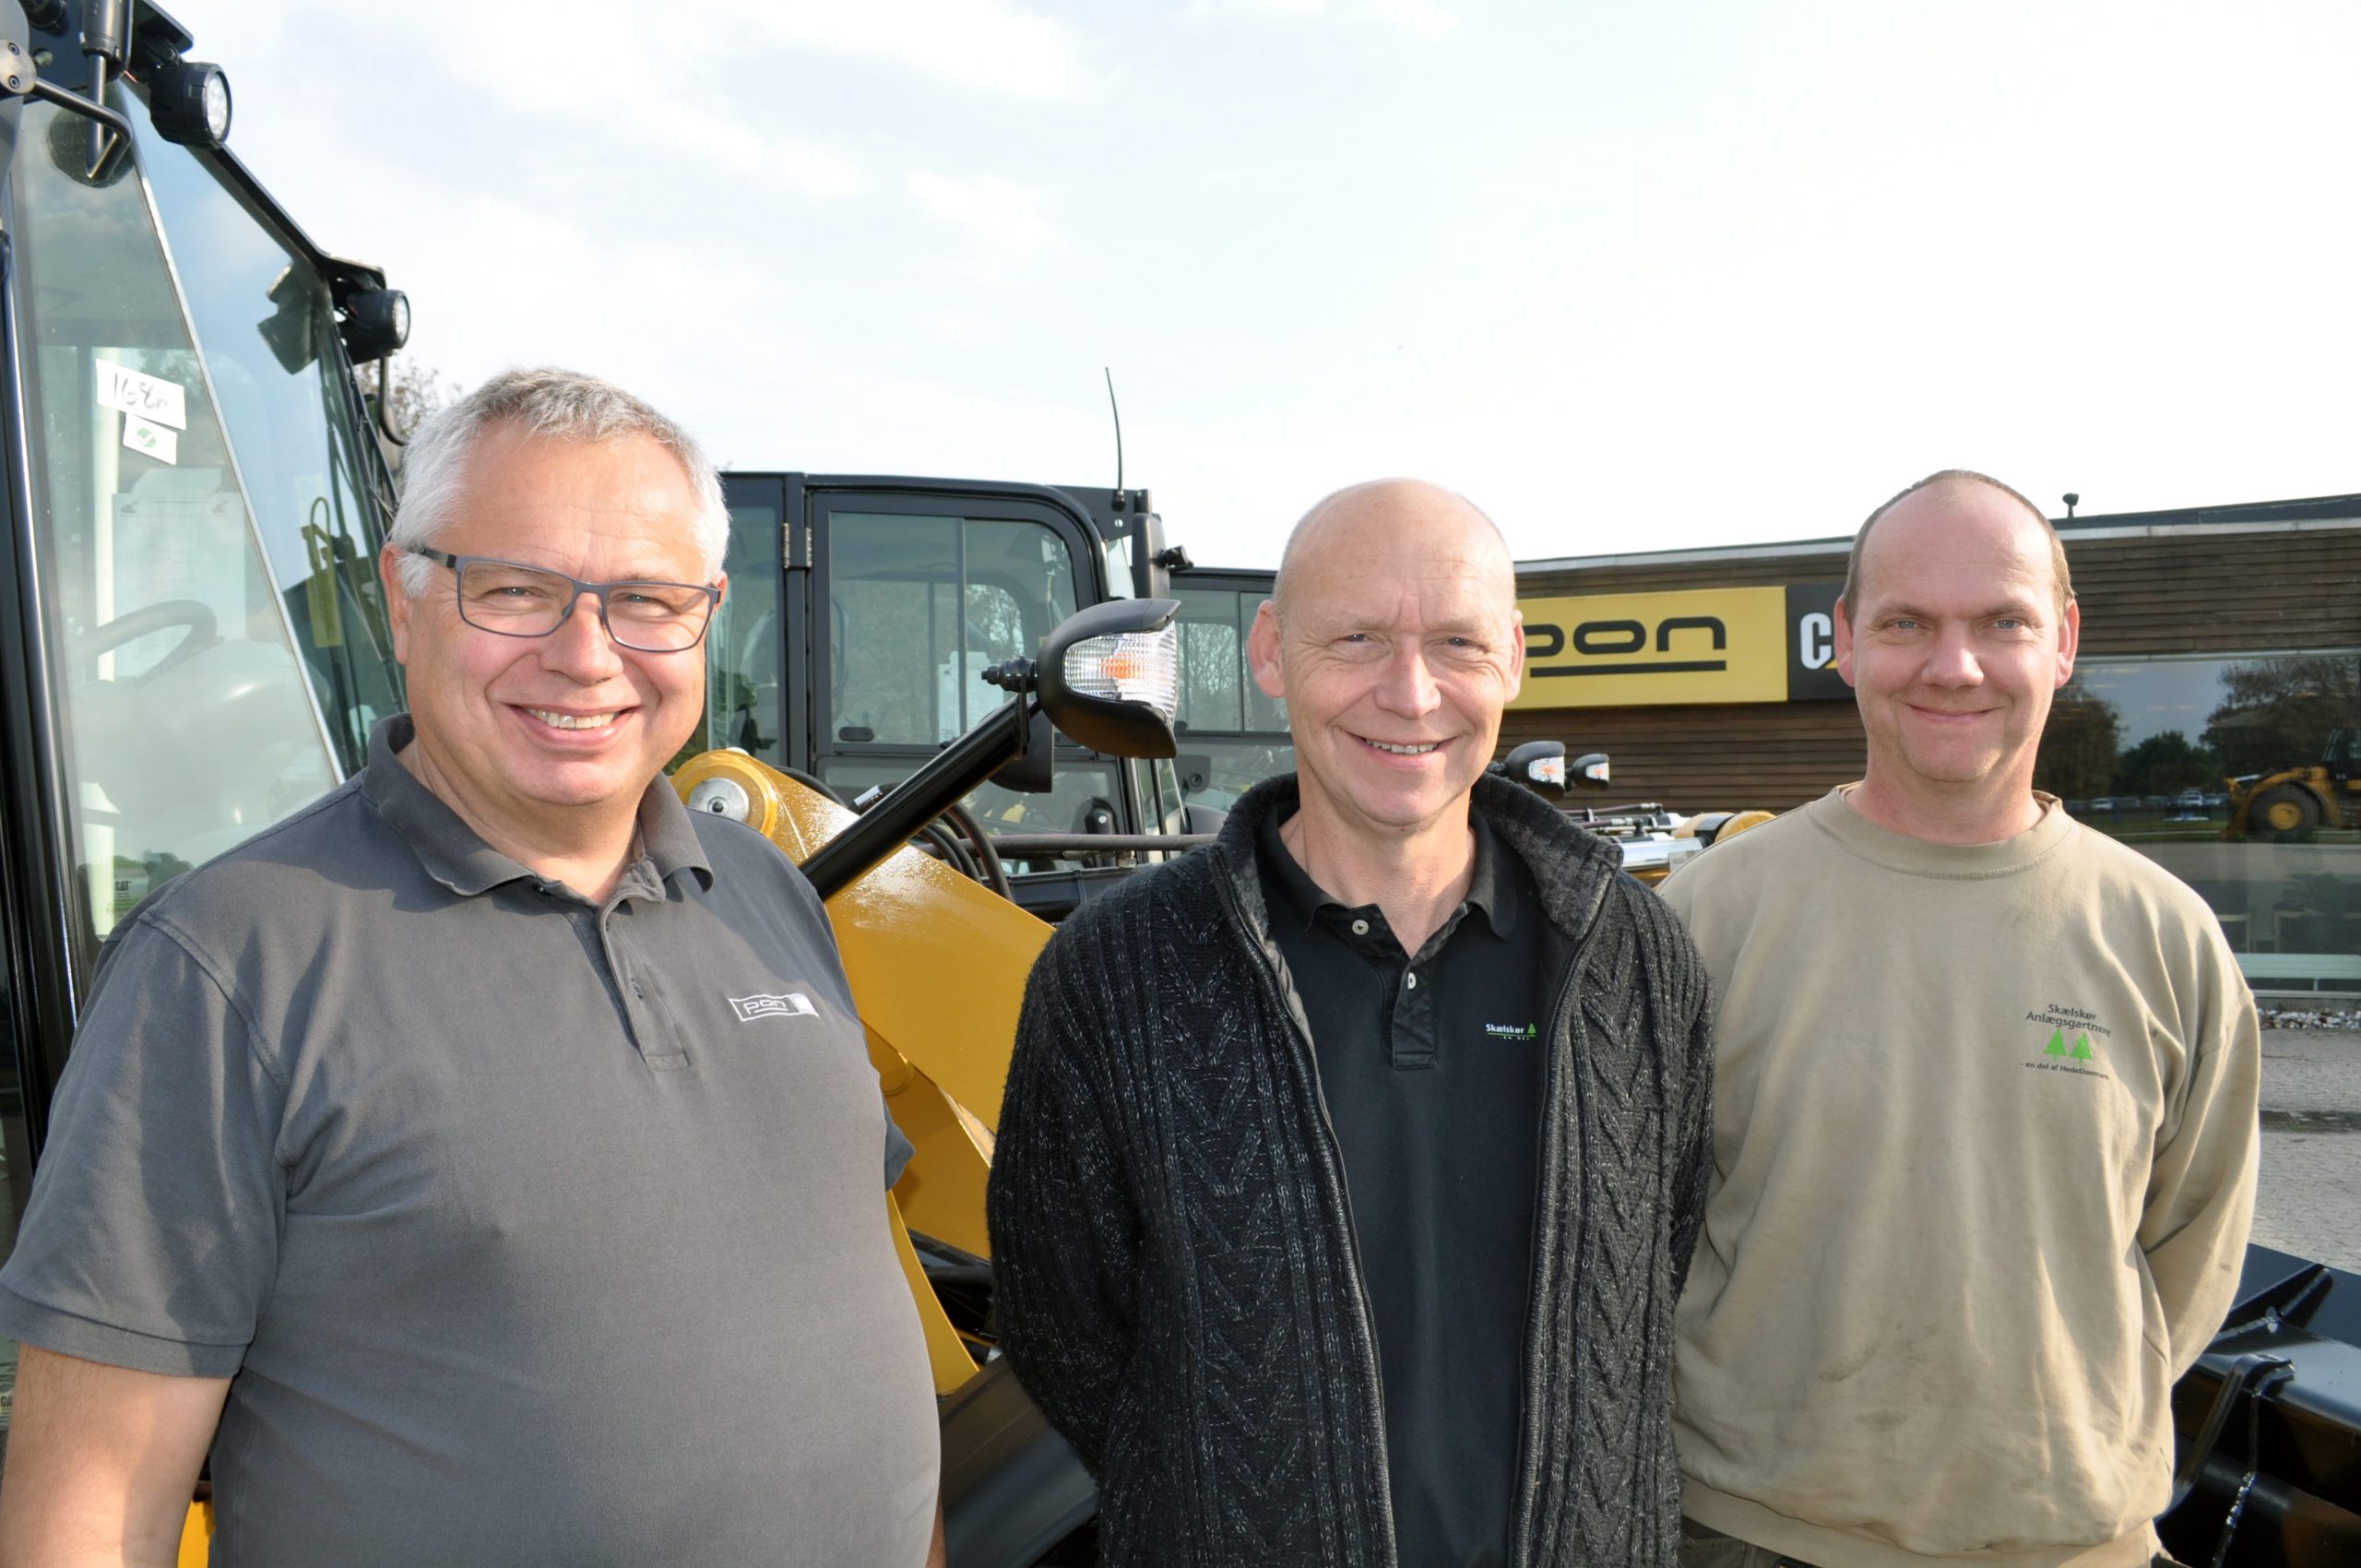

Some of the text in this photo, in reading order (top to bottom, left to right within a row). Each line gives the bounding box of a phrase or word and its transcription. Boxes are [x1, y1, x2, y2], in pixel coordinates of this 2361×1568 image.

[2047, 1004, 2097, 1021] Skælskør
[2026, 1011, 2111, 1038] Anlægsgartnere
[2036, 1062, 2049, 1070] del
